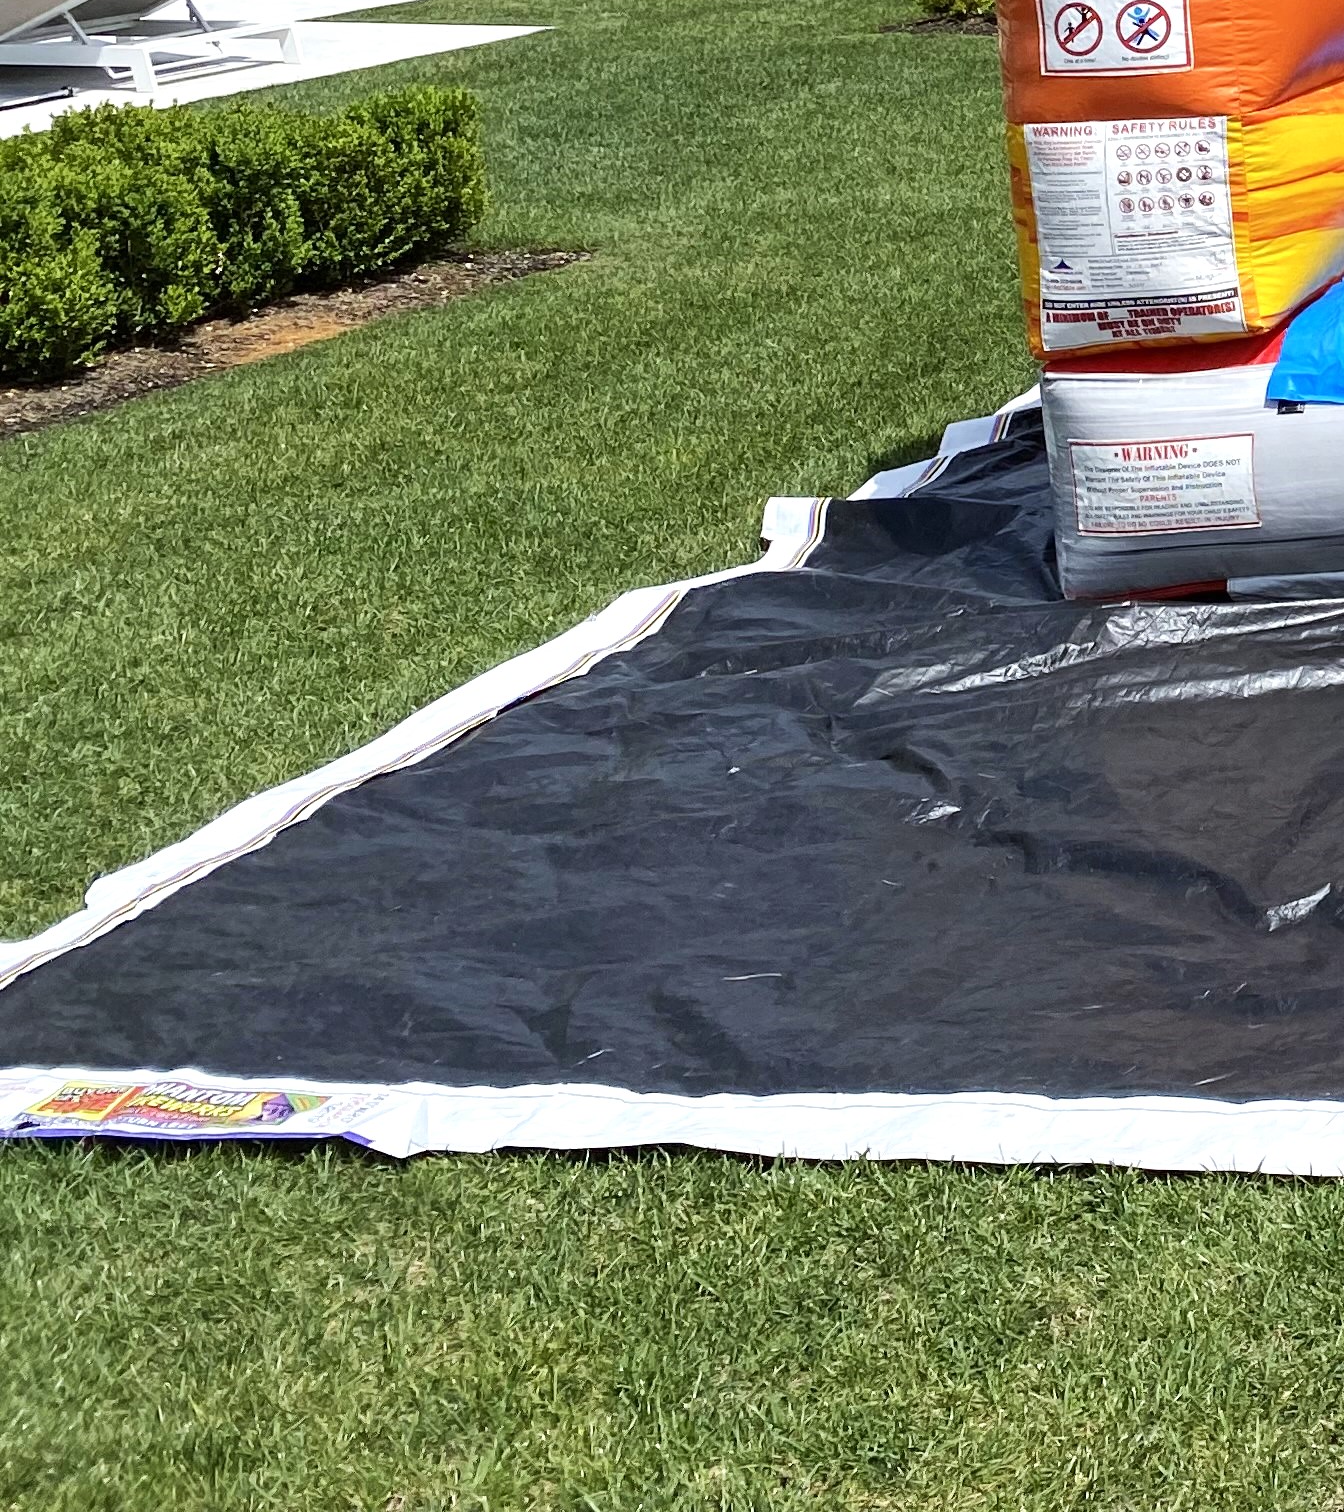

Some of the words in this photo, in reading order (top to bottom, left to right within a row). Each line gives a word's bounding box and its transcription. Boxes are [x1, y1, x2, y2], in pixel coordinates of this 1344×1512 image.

[1112, 122, 1165, 135] SAFETY
[1169, 117, 1216, 131] RULES
[1121, 444, 1188, 462] WARNING
[1203, 460, 1224, 468] DOES
[1226, 458, 1241, 466] NOT
[1168, 472, 1200, 480] Inflatable
[1139, 493, 1177, 502] PARENTS
